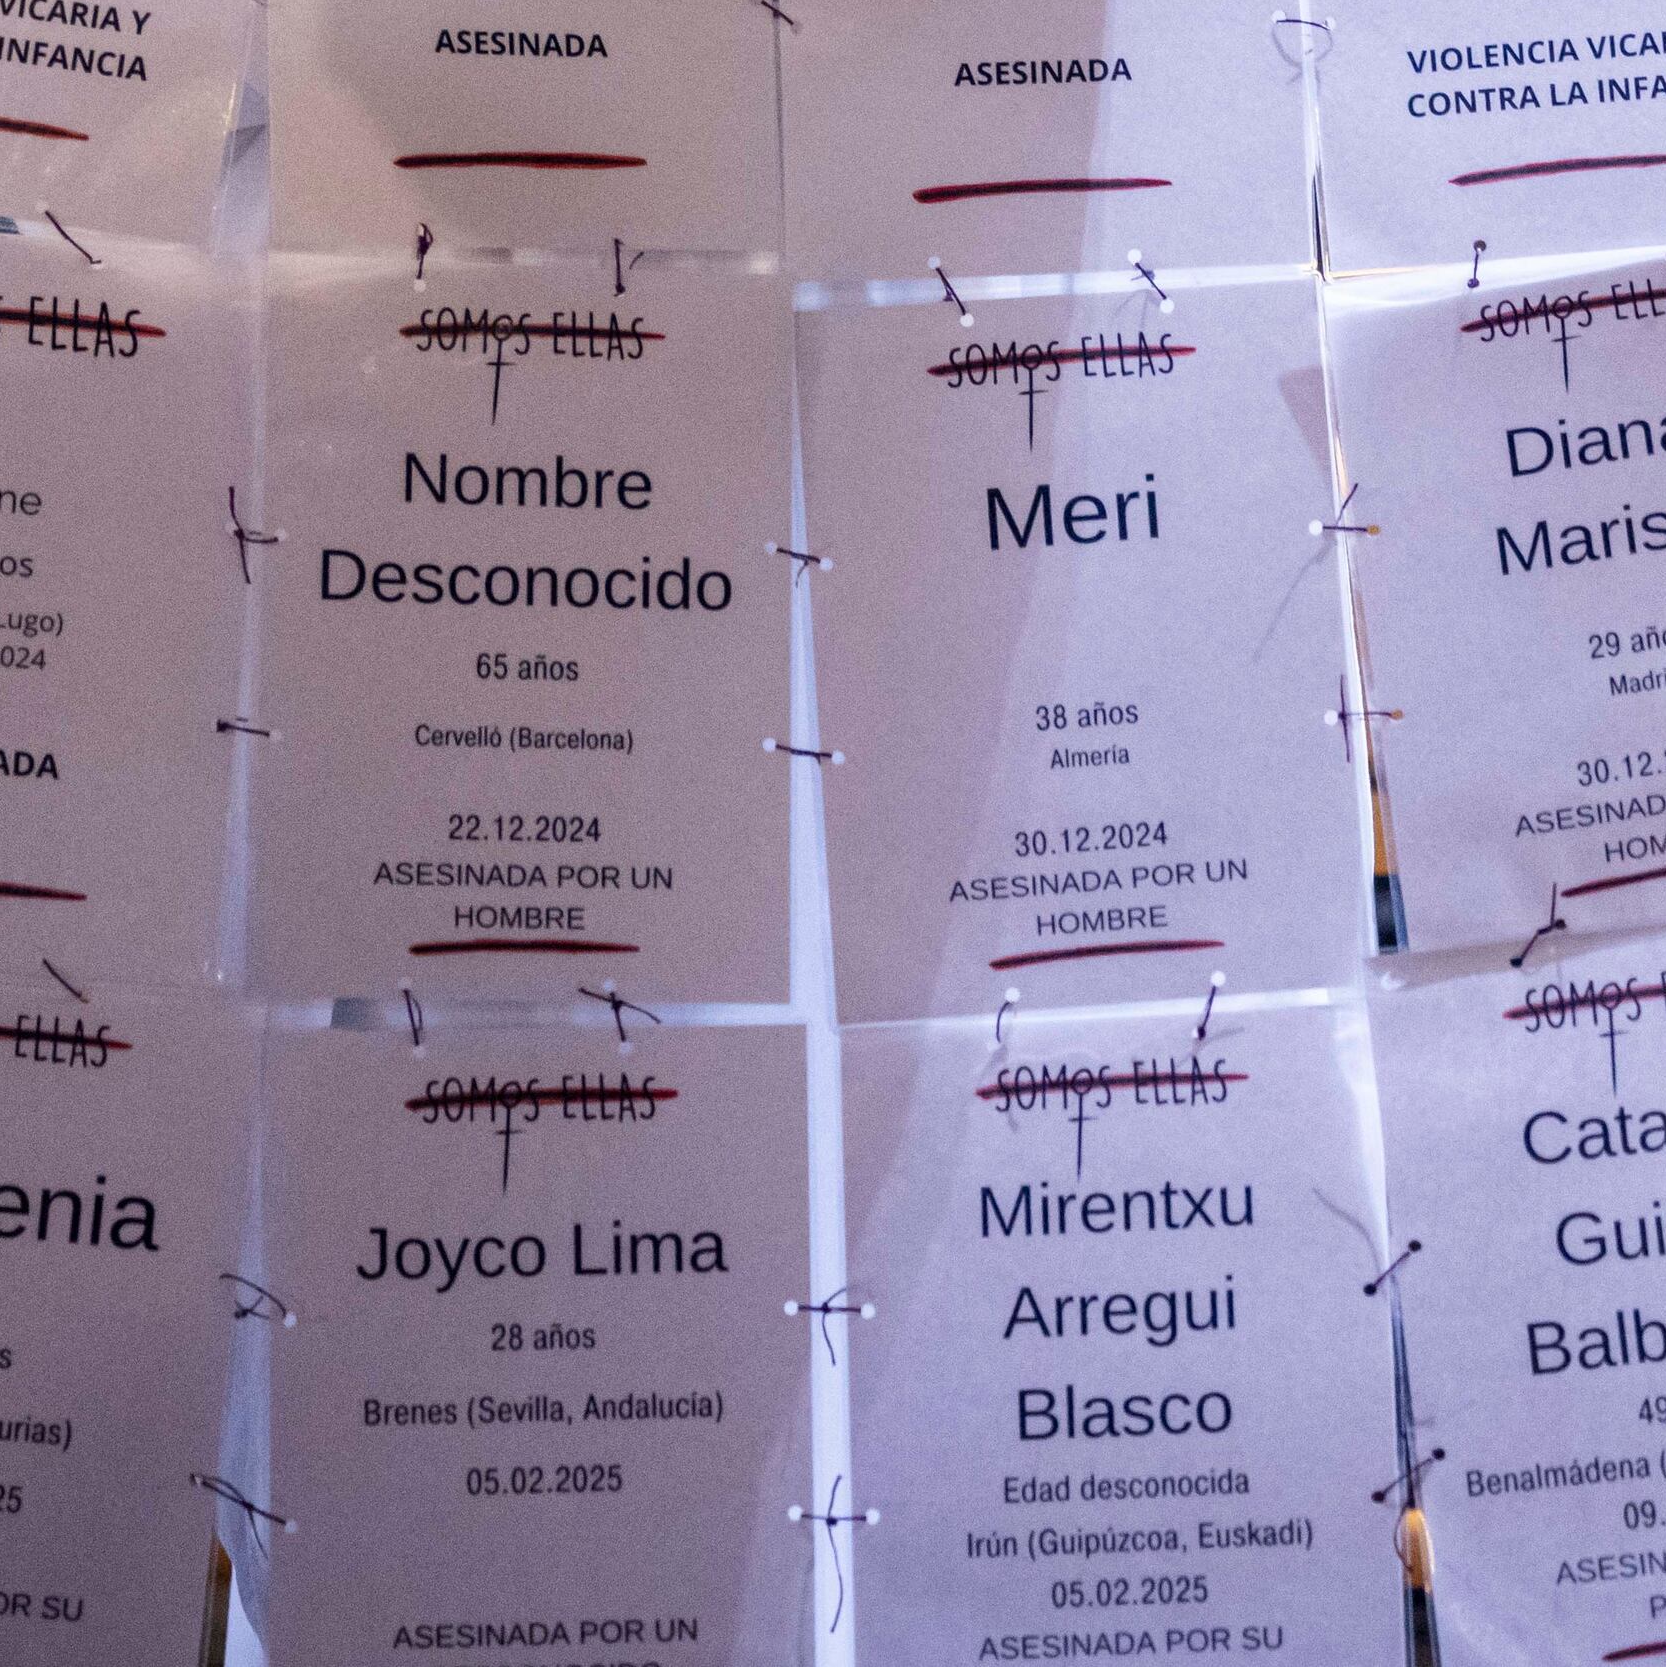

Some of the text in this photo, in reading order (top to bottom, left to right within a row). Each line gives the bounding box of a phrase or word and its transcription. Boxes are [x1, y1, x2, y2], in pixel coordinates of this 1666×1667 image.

[132, 10, 151, 35] Y
[434, 28, 609, 58] ASESINADA
[404, 451, 653, 511] Nombre
[986, 472, 1160, 551] Meri
[320, 548, 733, 612] Desconocido
[413, 722, 635, 755] Cervelló (Barcelona)
[1049, 748, 1131, 769] Almería
[448, 813, 602, 843] 22.12.2024
[1014, 820, 1169, 858] 30.12.2024
[980, 1182, 1254, 1238] Mirentxu
[356, 1219, 729, 1294] Joyco Lima
[1003, 1274, 1236, 1348] Arregui
[362, 1391, 725, 1428] Brenes (Sevilla, Andalucía)
[1017, 1384, 1233, 1441] Blasco
[1002, 1468, 1251, 1505] Edad desconocida
[1465, 1457, 1651, 1499] Benalmádena
